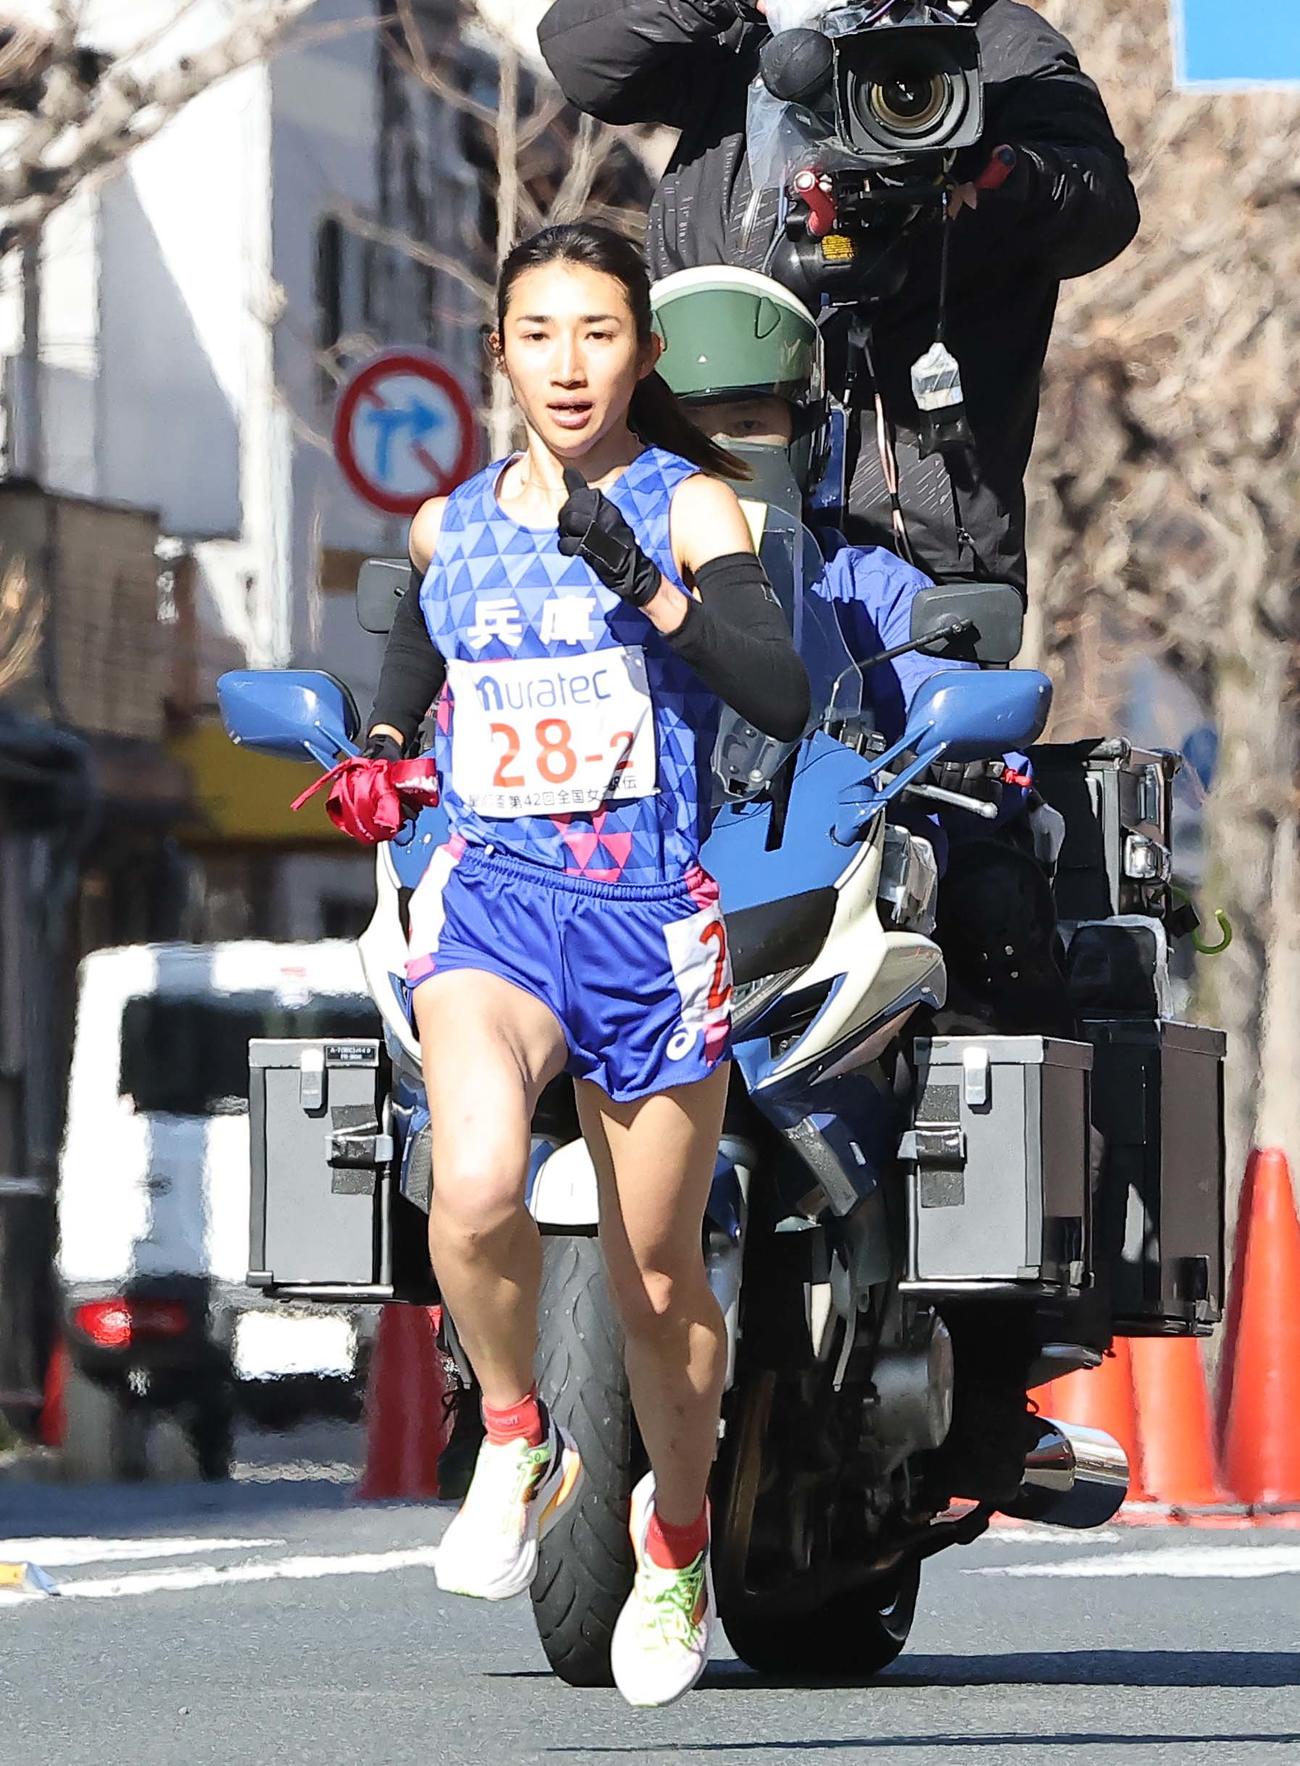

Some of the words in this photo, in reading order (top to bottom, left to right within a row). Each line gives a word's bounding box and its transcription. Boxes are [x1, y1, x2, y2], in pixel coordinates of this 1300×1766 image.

[466, 594, 597, 649] 兵庫
[490, 718, 635, 788] 28-2
[699, 920, 733, 1010] 2
